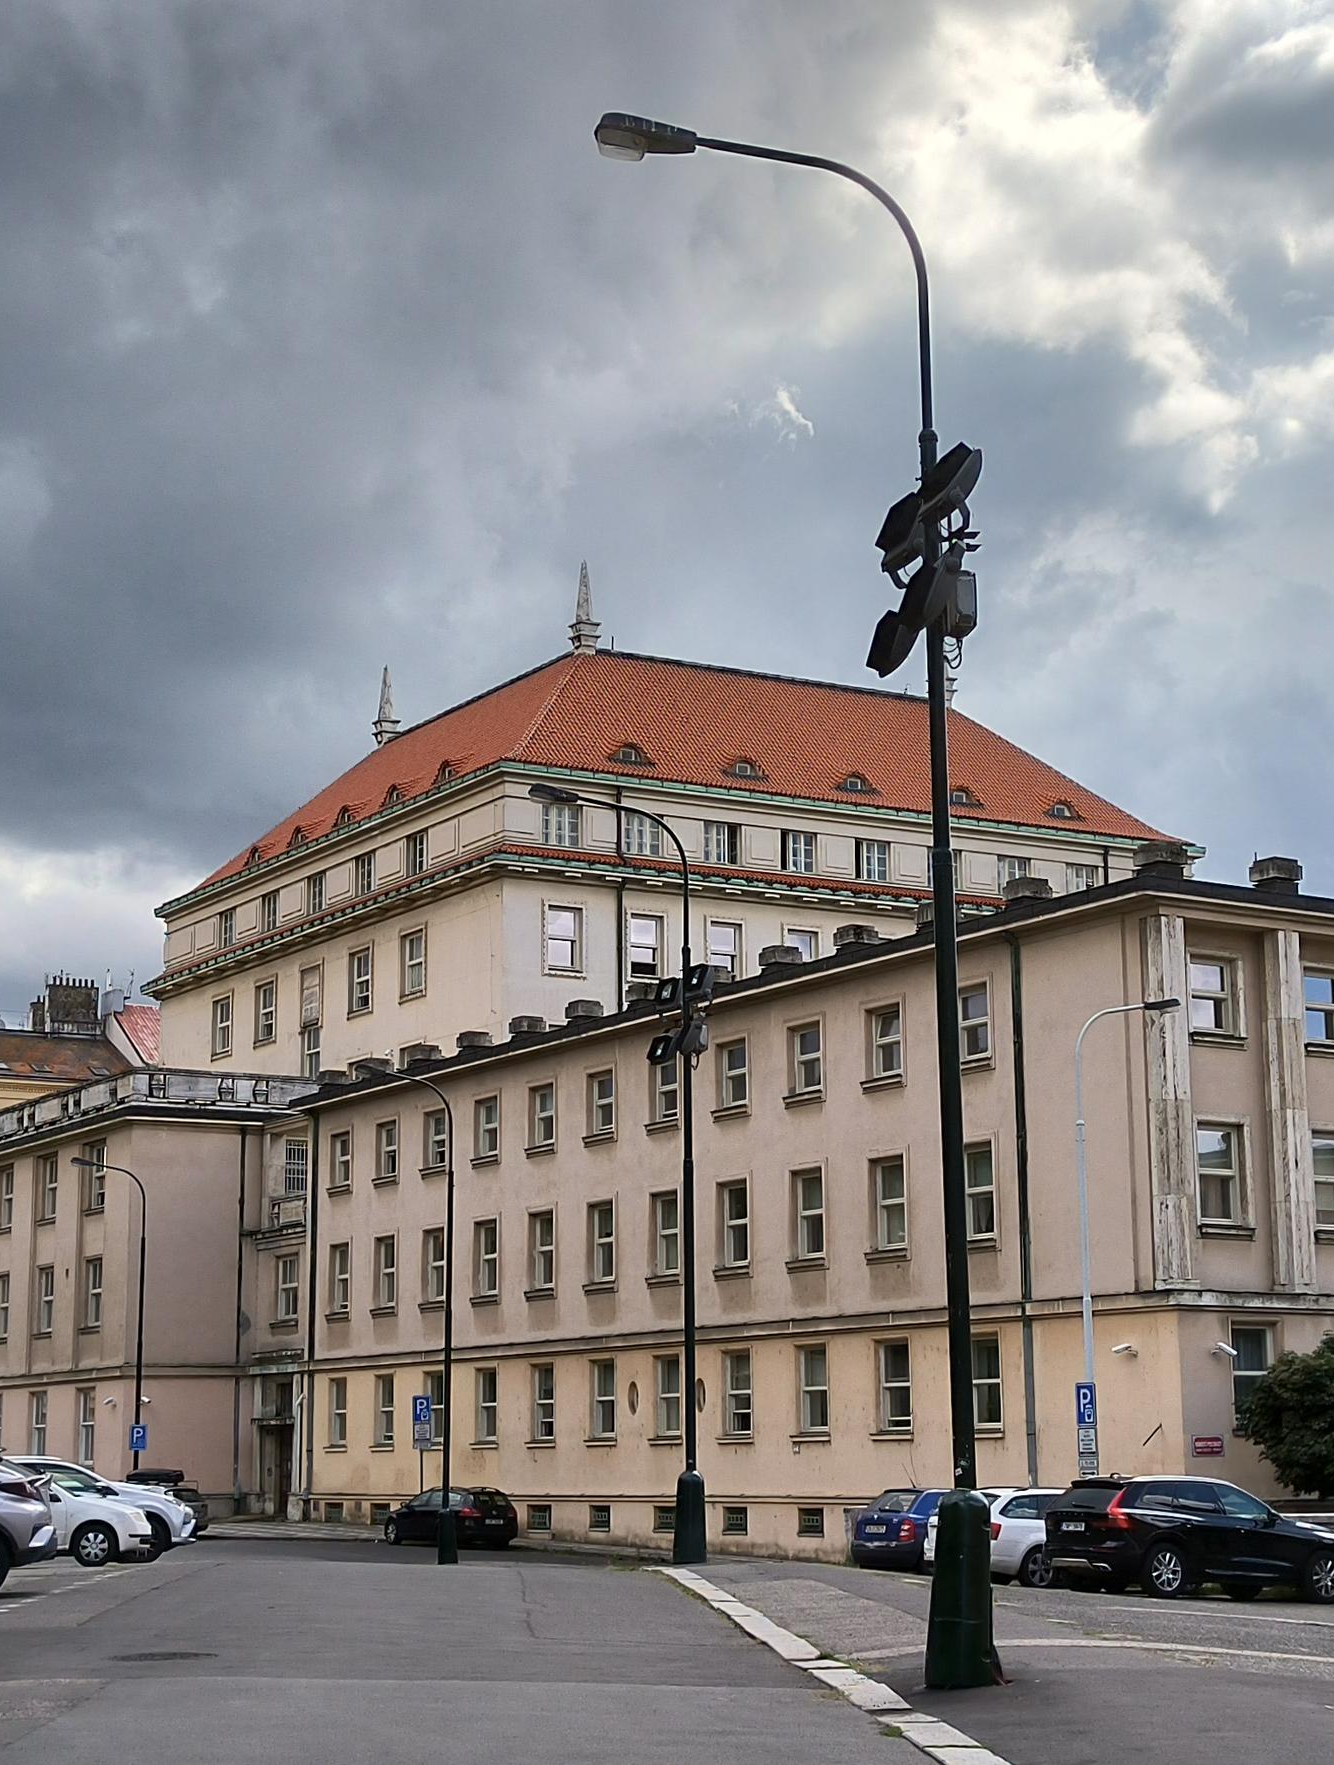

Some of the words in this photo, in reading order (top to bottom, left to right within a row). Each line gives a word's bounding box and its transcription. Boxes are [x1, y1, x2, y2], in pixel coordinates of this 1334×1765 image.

[416, 1399, 427, 1415] P
[1080, 1388, 1091, 1413] P
[133, 1427, 143, 1444] P
